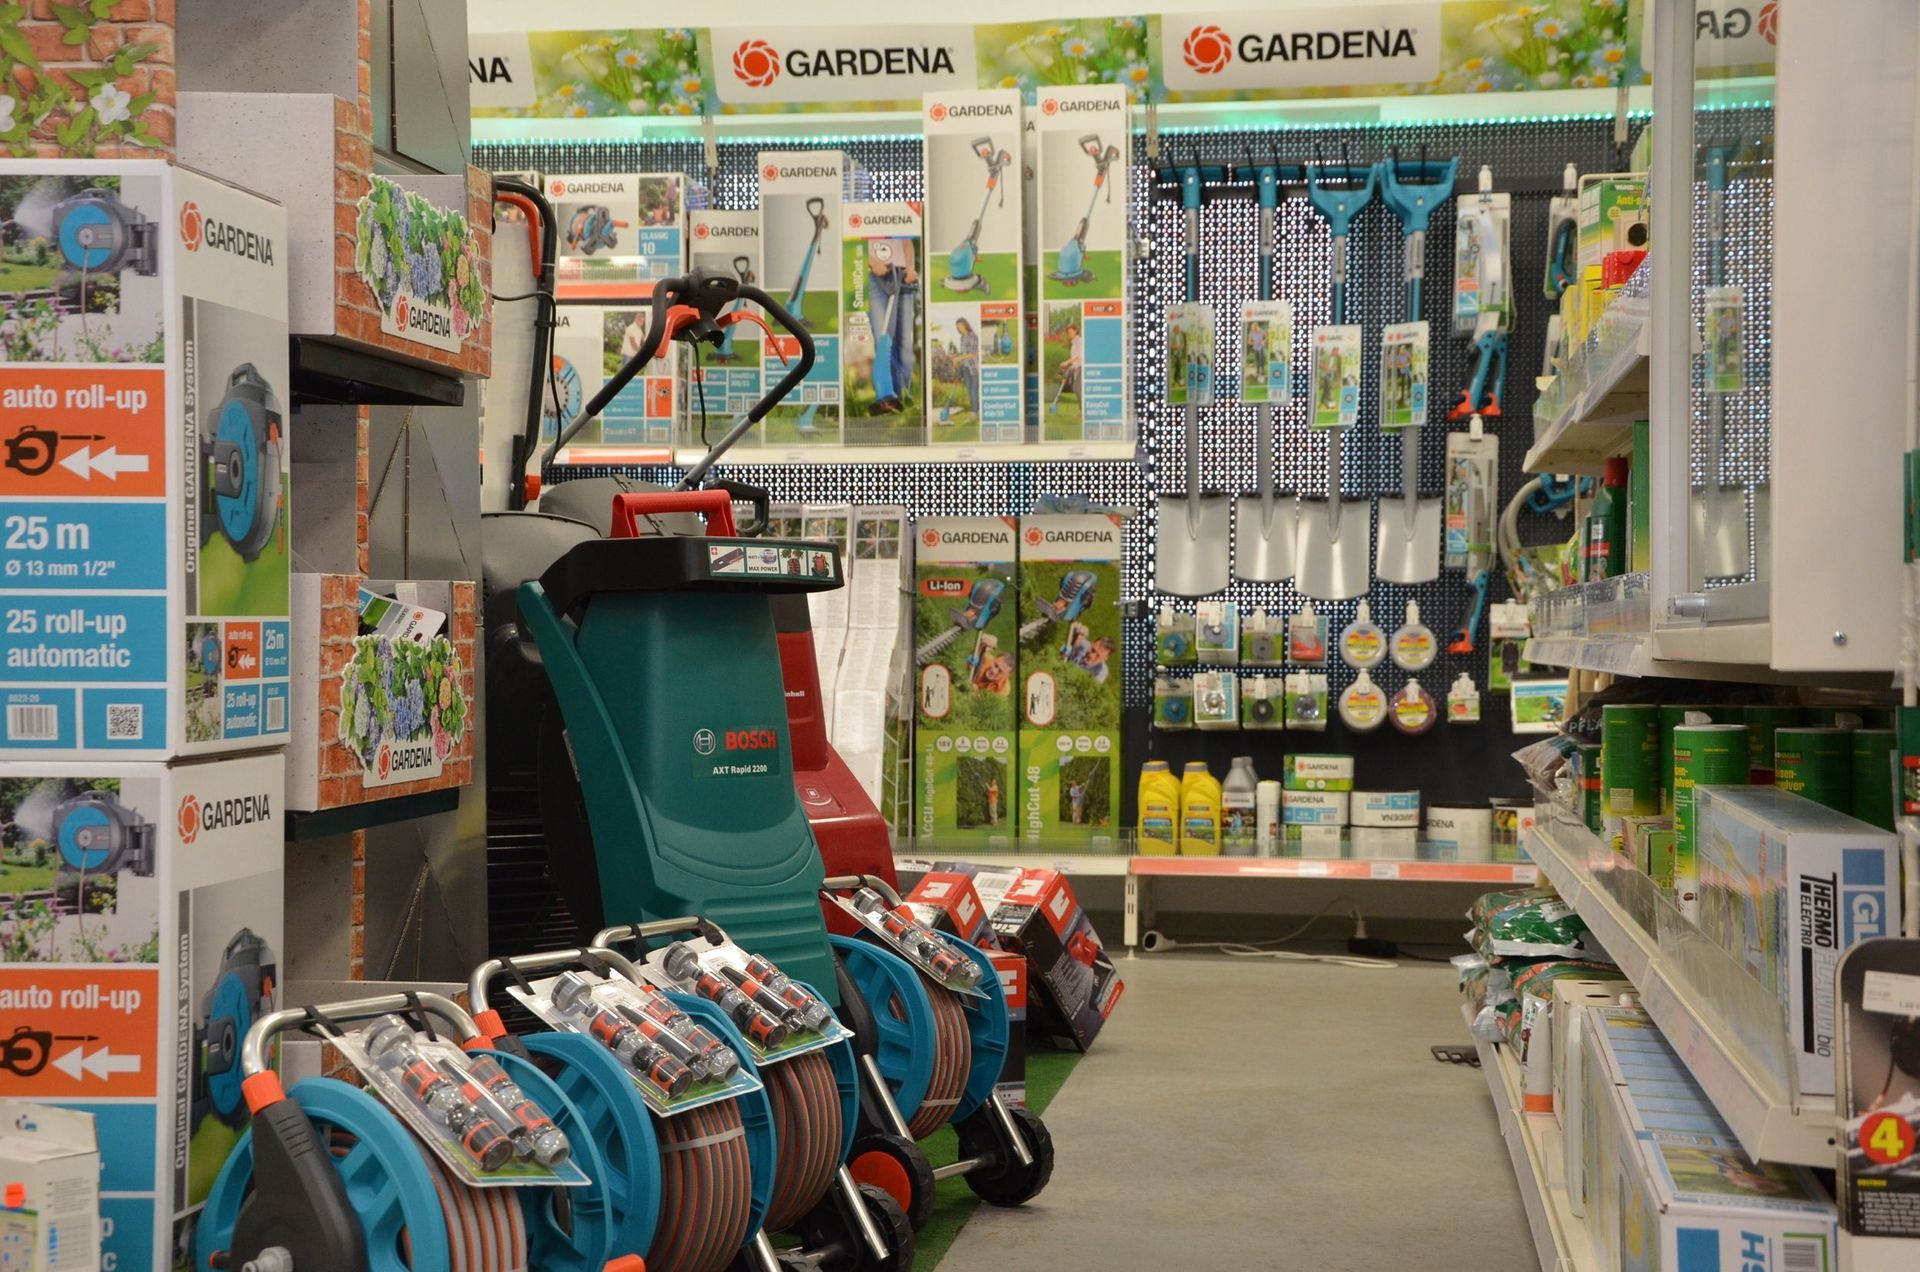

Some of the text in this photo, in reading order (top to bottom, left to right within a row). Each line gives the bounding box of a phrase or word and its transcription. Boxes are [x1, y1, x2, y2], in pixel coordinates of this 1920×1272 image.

[1238, 28, 1417, 62] GARDENA
[785, 46, 954, 78] GARDENA
[949, 104, 1013, 118] GARDENA
[1060, 100, 1121, 113] GARDENA
[780, 166, 837, 178] GARDENA
[567, 182, 625, 194] GARDENA
[711, 226, 758, 237] GARDEN
[864, 215, 913, 226] GARDENA
[204, 218, 274, 267] GARDENA
[641, 242, 656, 255] 10
[409, 305, 451, 339] GARDENA
[3, 384, 148, 414] auto roll-up
[184, 340, 197, 573] Original GARDENA System
[5, 515, 91, 550] 25 m
[942, 532, 1009, 544] GARDENA
[1045, 531, 1113, 543] GARDENA
[5, 560, 21, 577] Ø
[27, 560, 45, 576] 13
[48, 564, 80, 576] mm
[6, 608, 128, 638] 25 roll-up
[265, 629, 285, 650] 25 m
[8, 643, 131, 668] automatic
[226, 693, 235, 708] 25
[725, 730, 777, 750] BOSCH
[392, 746, 433, 771] GARDENA
[713, 764, 768, 775] AXT Rapid 2200
[1306, 763, 1339, 771] GARDENA
[1027, 766, 1041, 783] 48
[1288, 796, 1325, 804] GARDENA
[202, 794, 271, 831] GARDENA
[1801, 894, 1812, 946] ELECTRO
[1808, 872, 1838, 949] THERMO
[0, 983, 141, 1014] auto roll-up
[174, 933, 190, 1169] Original GARDENA System
[1817, 1034, 1833, 1057] bio
[1869, 1117, 1904, 1159] 4
